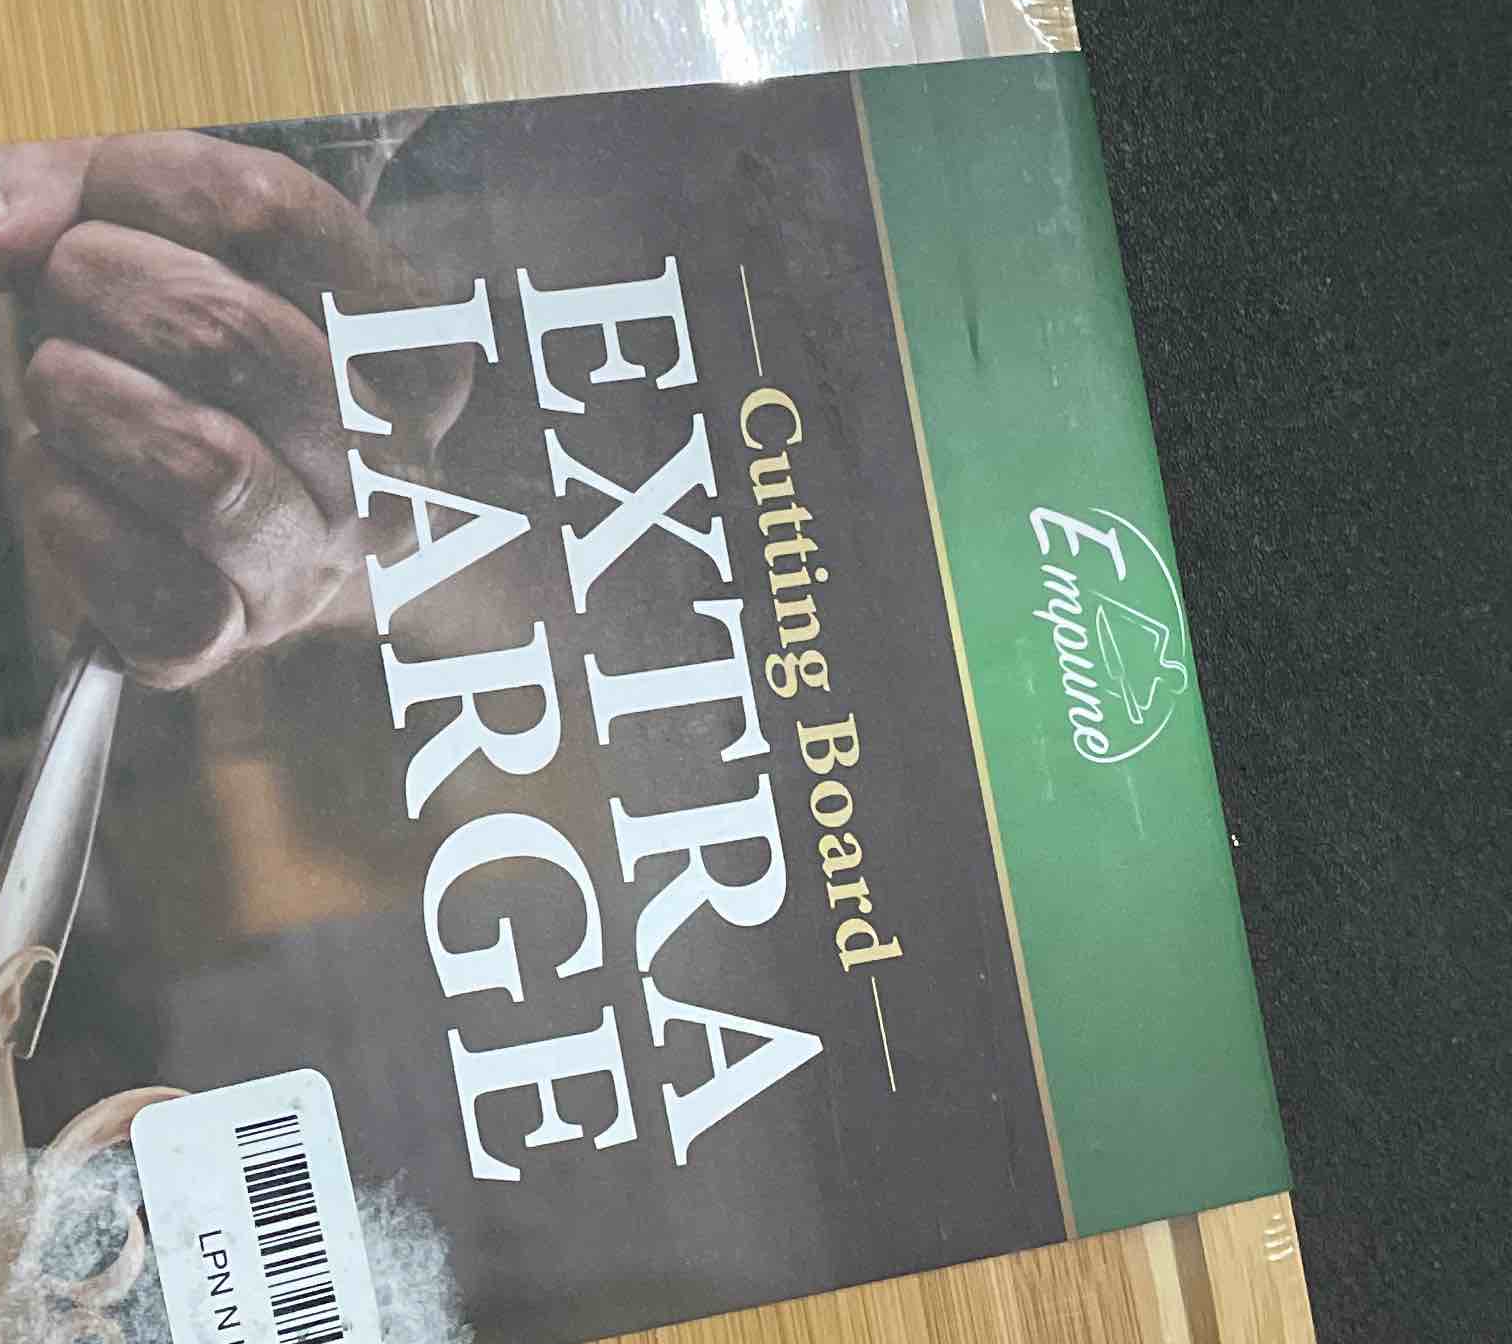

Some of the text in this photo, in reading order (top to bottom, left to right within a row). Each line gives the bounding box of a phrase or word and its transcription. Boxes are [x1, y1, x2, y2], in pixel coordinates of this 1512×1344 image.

[321, 277, 639, 1183] LARGE
[516, 255, 825, 1167] EXTRA
[738, 385, 904, 972] Cutting Board
